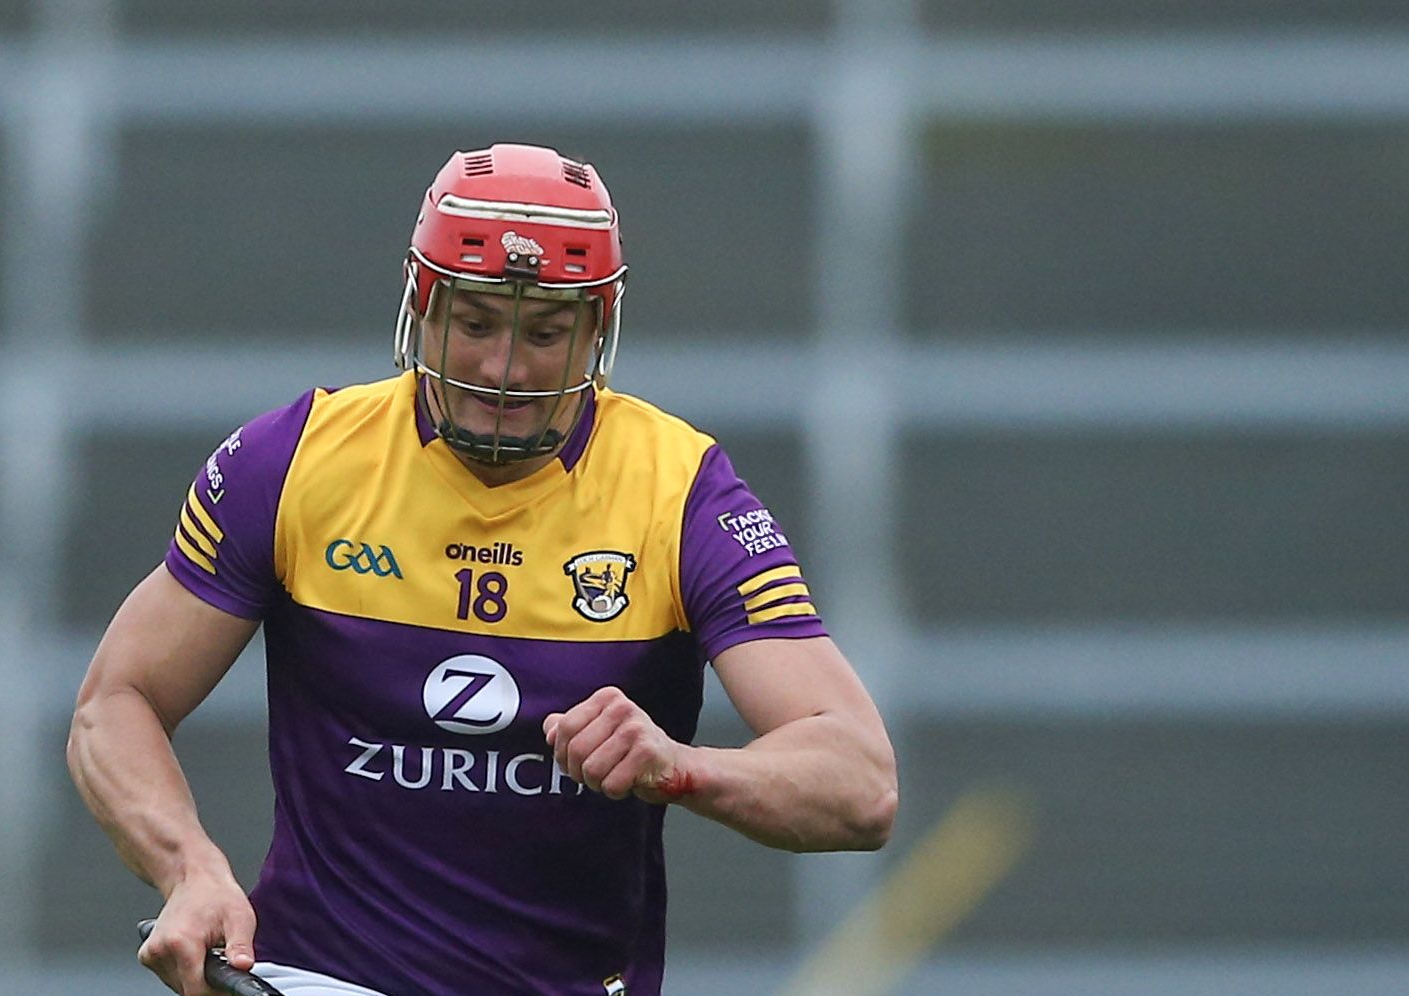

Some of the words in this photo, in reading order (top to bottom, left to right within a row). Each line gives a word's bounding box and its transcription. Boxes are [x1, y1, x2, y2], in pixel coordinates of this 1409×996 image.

[732, 521, 775, 546] YOUR
[325, 539, 404, 580] GAA
[454, 568, 508, 623] 18
